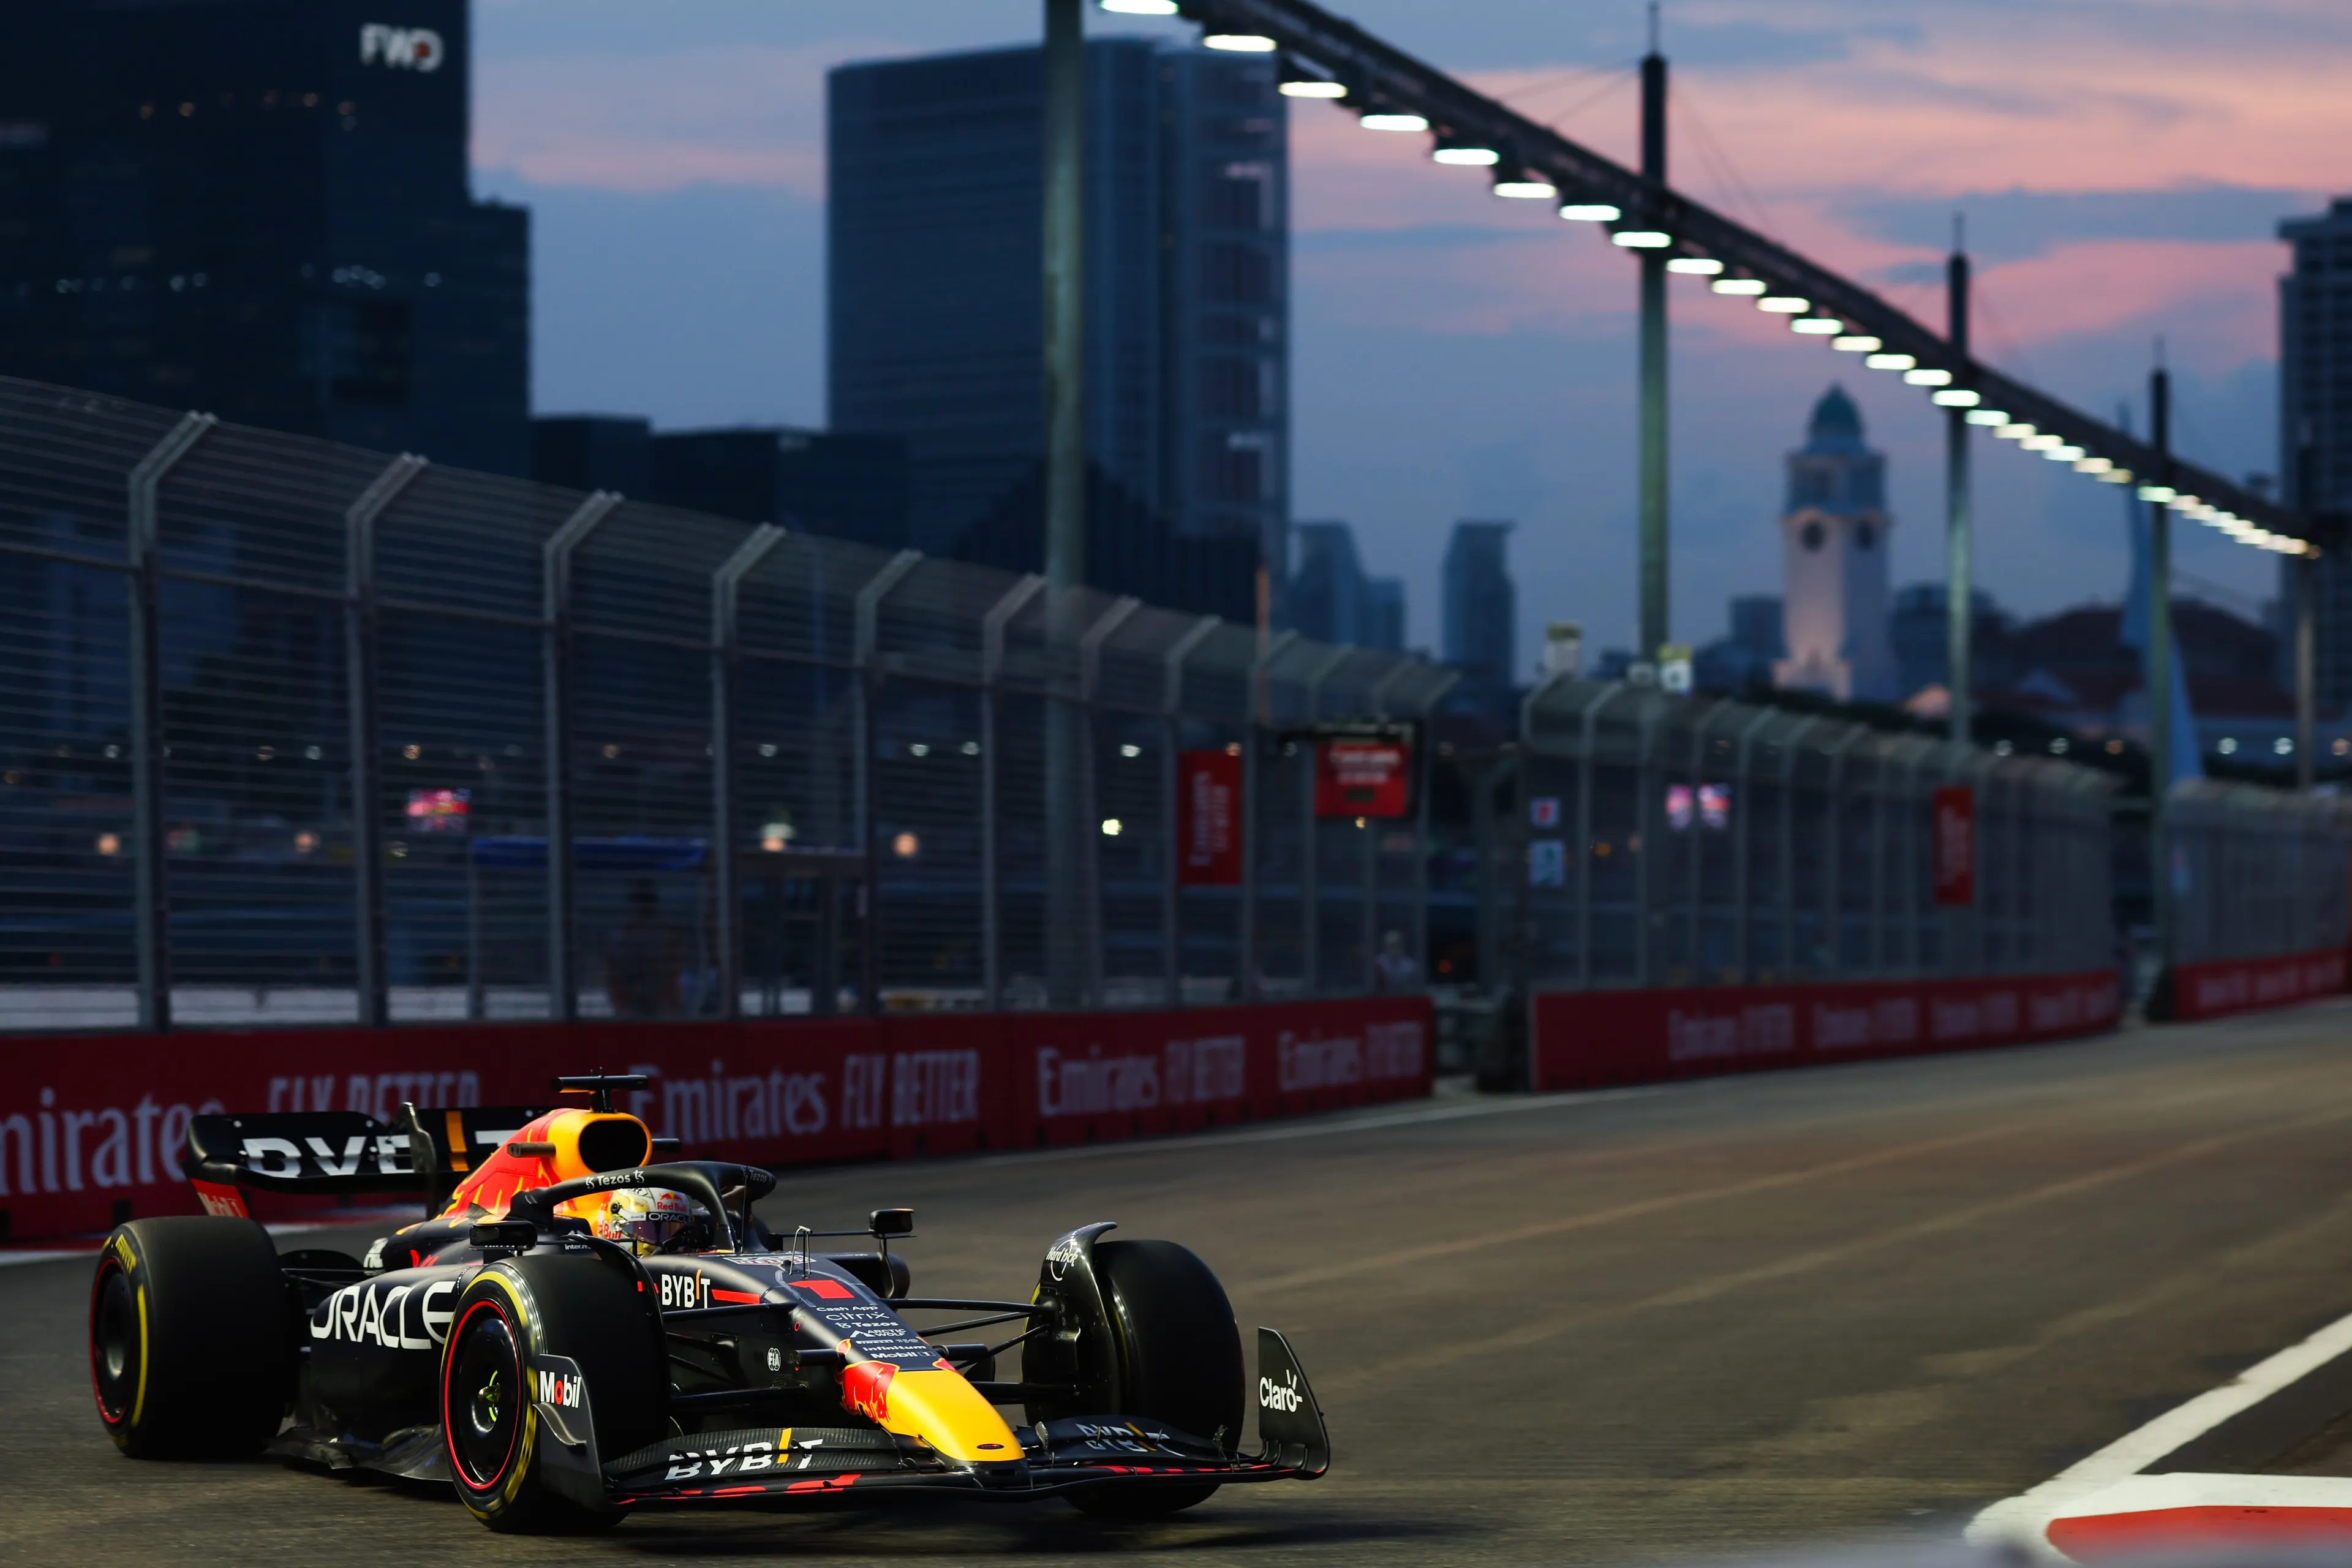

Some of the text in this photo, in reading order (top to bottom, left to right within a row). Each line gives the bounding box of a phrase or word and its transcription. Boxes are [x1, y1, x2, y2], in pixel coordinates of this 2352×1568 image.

[360, 23, 444, 73] FWD
[628, 1049, 979, 1144] Emirates FLY BETTER
[0, 1086, 226, 1196] mirate
[597, 1174, 631, 1186] Tezos
[649, 1213, 687, 1224] ORACL
[657, 1202, 687, 1213] Red Bull
[1046, 1246, 1066, 1262] Hard
[662, 1269, 710, 1310] BYBIT
[788, 1280, 855, 1299] 1
[311, 1281, 457, 1349] ORACLE
[826, 1311, 890, 1321] Citrix
[768, 1351, 781, 1368] FIA
[540, 1371, 582, 1408] Mobil
[1259, 1374, 1298, 1412] Claro
[665, 1428, 824, 1480] BYBIT
